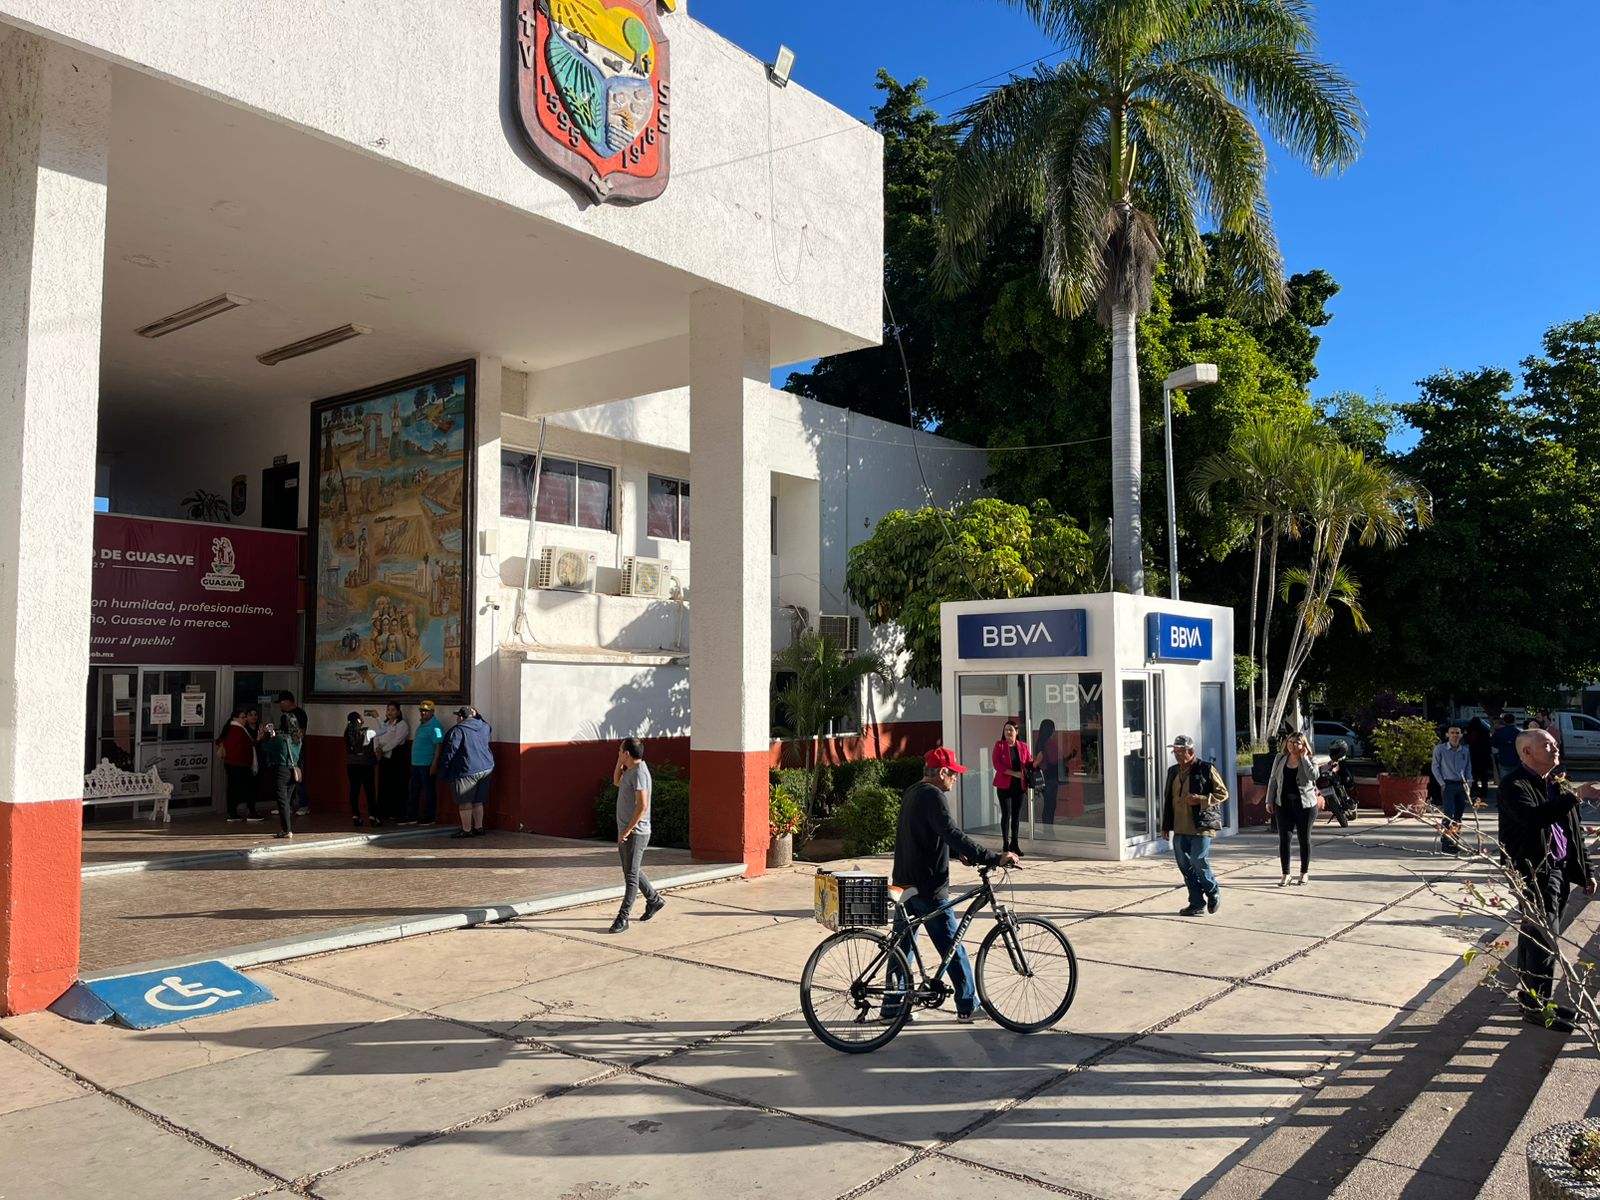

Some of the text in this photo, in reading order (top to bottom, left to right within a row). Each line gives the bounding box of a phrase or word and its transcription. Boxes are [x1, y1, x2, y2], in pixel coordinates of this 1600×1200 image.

[541, 75, 581, 148] 1595
[622, 126, 656, 169] 1916
[93, 561, 105, 569] 27
[100, 548, 122, 561] DE
[125, 550, 195, 566] GUASAVE
[202, 578, 244, 588] GUASAVE
[91, 598, 274, 616] on humildad, profesionalismo,
[111, 614, 167, 627] Guasave
[169, 616, 181, 627] lo
[183, 619, 231, 629] merece.
[119, 635, 132, 646] al
[132, 636, 176, 648] pueblo!
[982, 621, 1053, 647] BBVA
[1170, 625, 1202, 648] BBVA
[90, 650, 115, 658] ob.mx
[173, 756, 208, 767] $6,000
